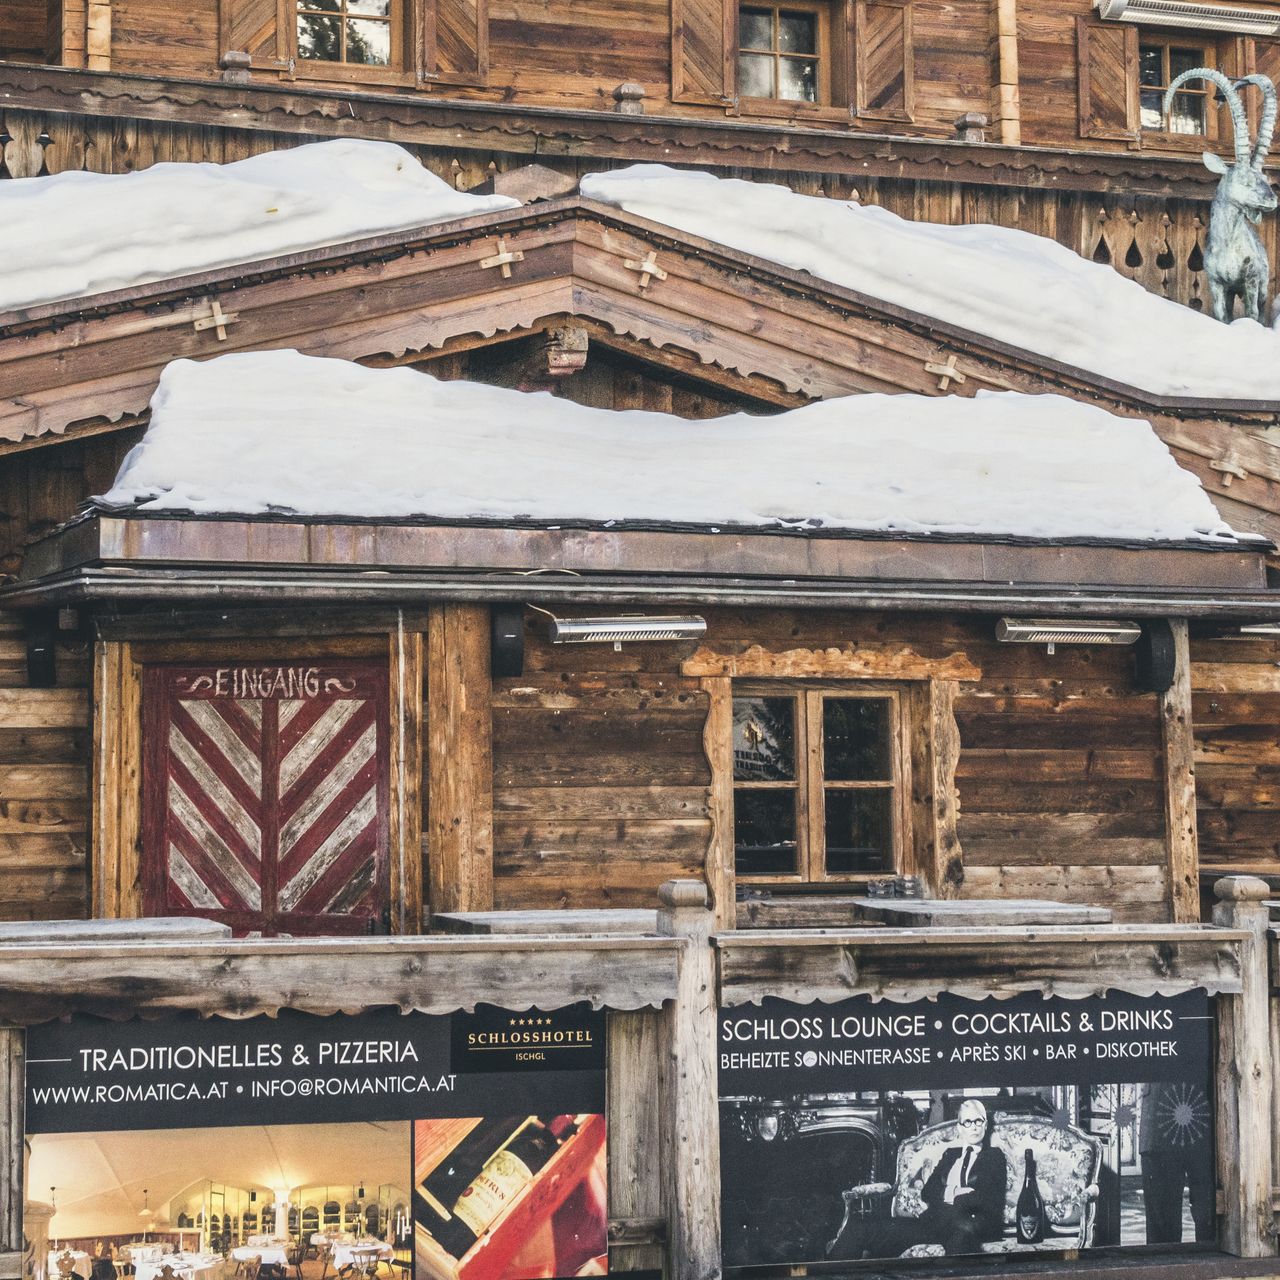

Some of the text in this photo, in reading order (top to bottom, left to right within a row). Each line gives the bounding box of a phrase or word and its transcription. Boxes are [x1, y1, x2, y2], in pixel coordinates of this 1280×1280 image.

[214, 666, 321, 698] EINGANG
[467, 1030, 593, 1045] SCHLOSSHOTEL
[722, 1008, 1174, 1042] SCHLOSS LOUNGE COCKTAILS & DRINKS
[79, 1040, 419, 1072] TRADITIONELLES & PIZZERIA
[515, 1052, 546, 1062] ISCHGL
[720, 1051, 790, 1070] BEHEIZTE
[950, 1041, 1000, 1063] APRÈS
[1003, 1044, 1027, 1062] SKI
[1045, 1043, 1077, 1060] BAR
[1095, 1040, 1179, 1059] DISKOTHEK
[32, 1074, 457, 1105] WWW.ROMATICA.AT INFO@ROMANTICA.AT
